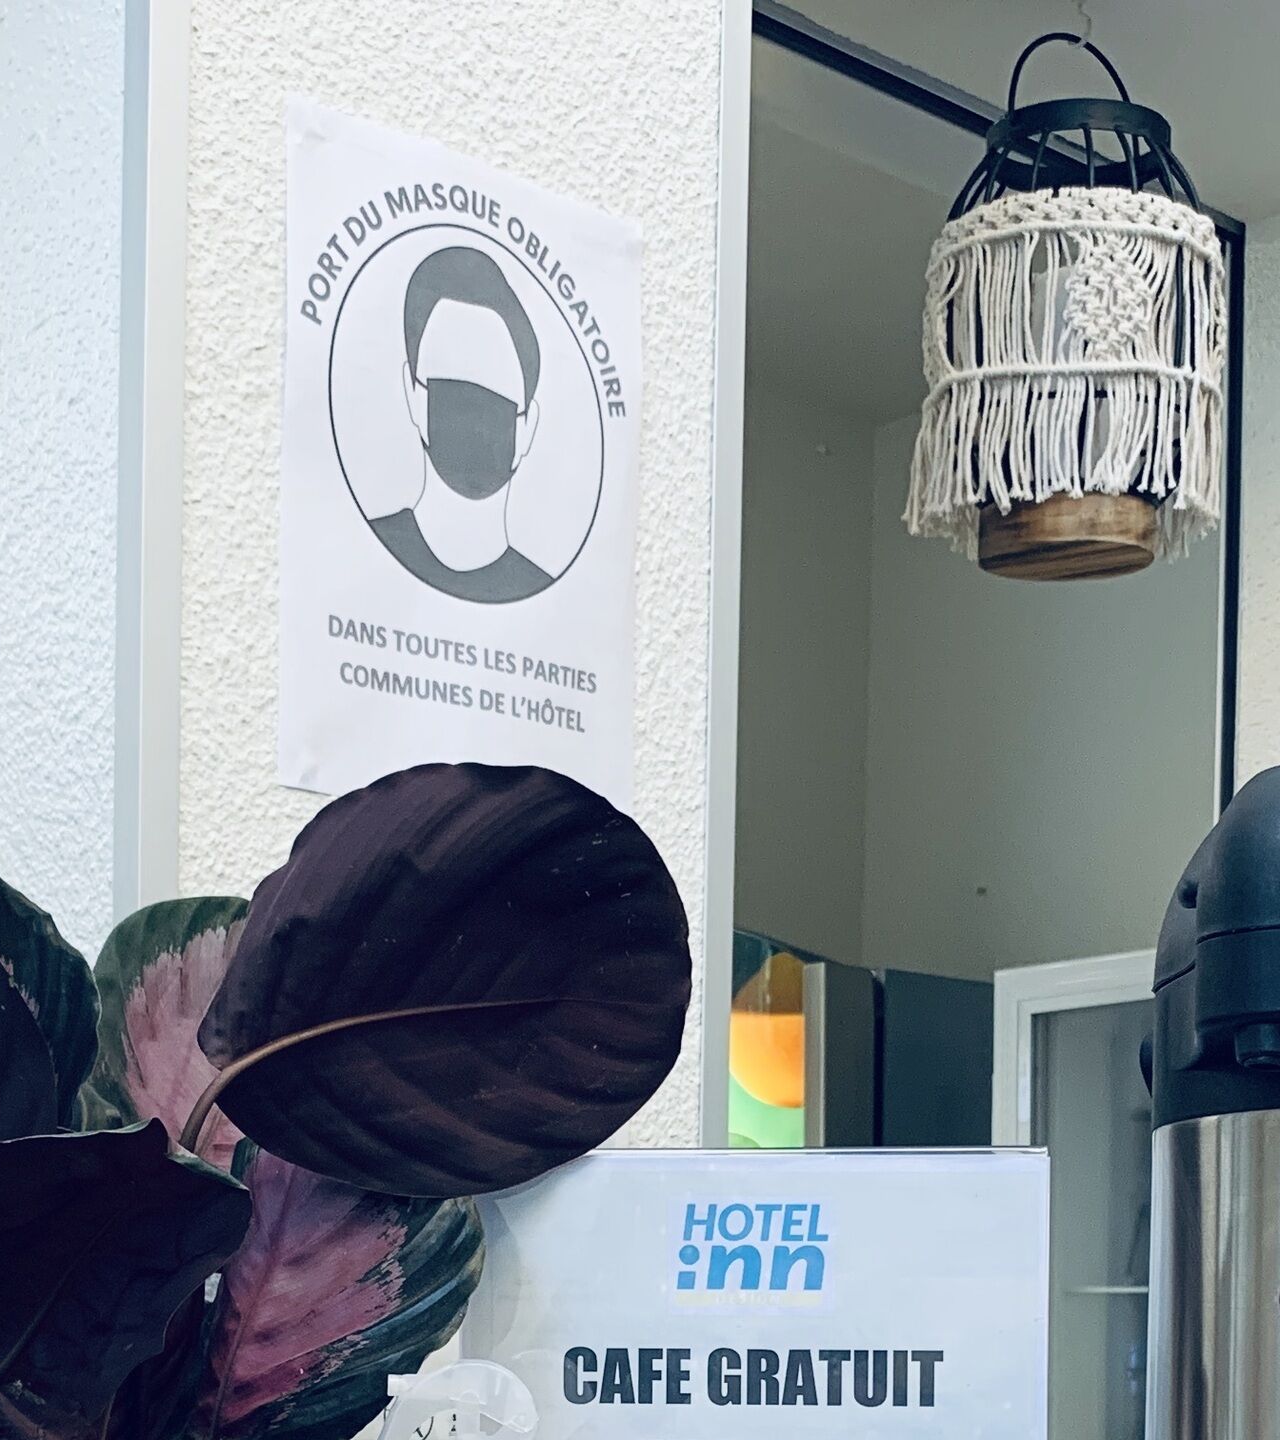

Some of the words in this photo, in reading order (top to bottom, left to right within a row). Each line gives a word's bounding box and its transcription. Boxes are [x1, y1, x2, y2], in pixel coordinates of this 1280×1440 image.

[300, 234, 349, 325] PORT
[342, 200, 383, 246] DU
[384, 183, 500, 228] MASQUE
[507, 216, 625, 418] OBLIGATOIRE
[328, 615, 387, 648] DANS
[393, 630, 477, 666] TOUTES
[484, 648, 516, 675] LES
[522, 657, 597, 694] PARTIES
[340, 662, 473, 707] COMMUNES
[479, 689, 505, 714] DE
[512, 696, 585, 733] L'HÔTEL
[683, 1203, 828, 1241] HOTEL
[677, 1244, 825, 1290] inn
[563, 1347, 691, 1405] CAFE
[707, 1348, 944, 1407] GRATUIT
